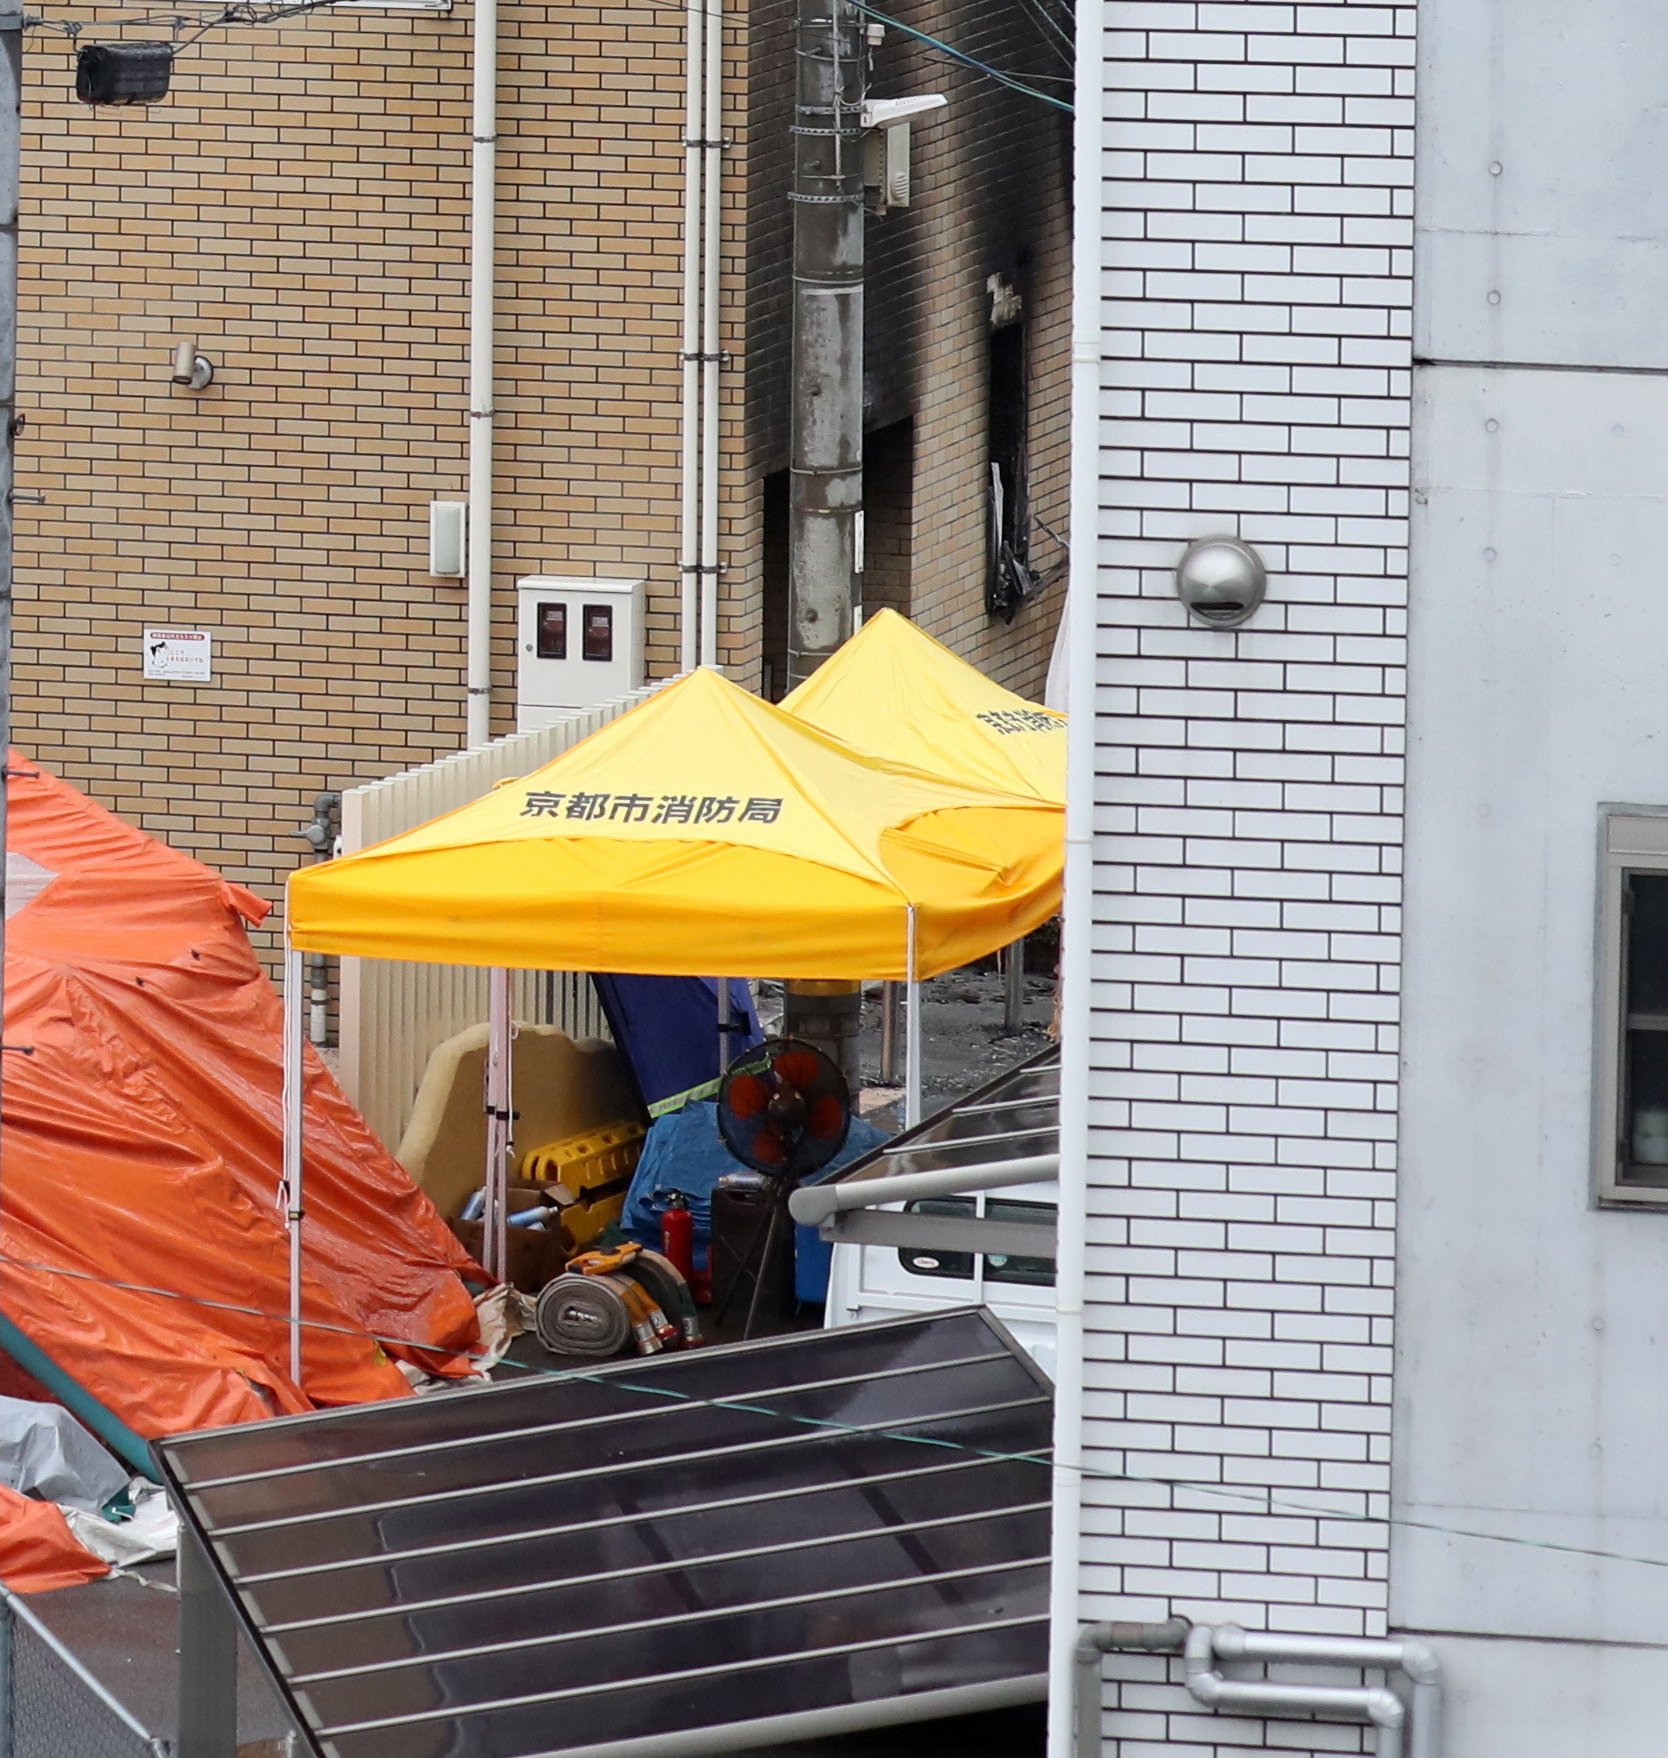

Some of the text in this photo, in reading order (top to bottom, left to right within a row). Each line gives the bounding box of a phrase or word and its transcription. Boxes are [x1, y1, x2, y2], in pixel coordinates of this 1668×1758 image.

[520, 790, 784, 825] 京都市消防局
